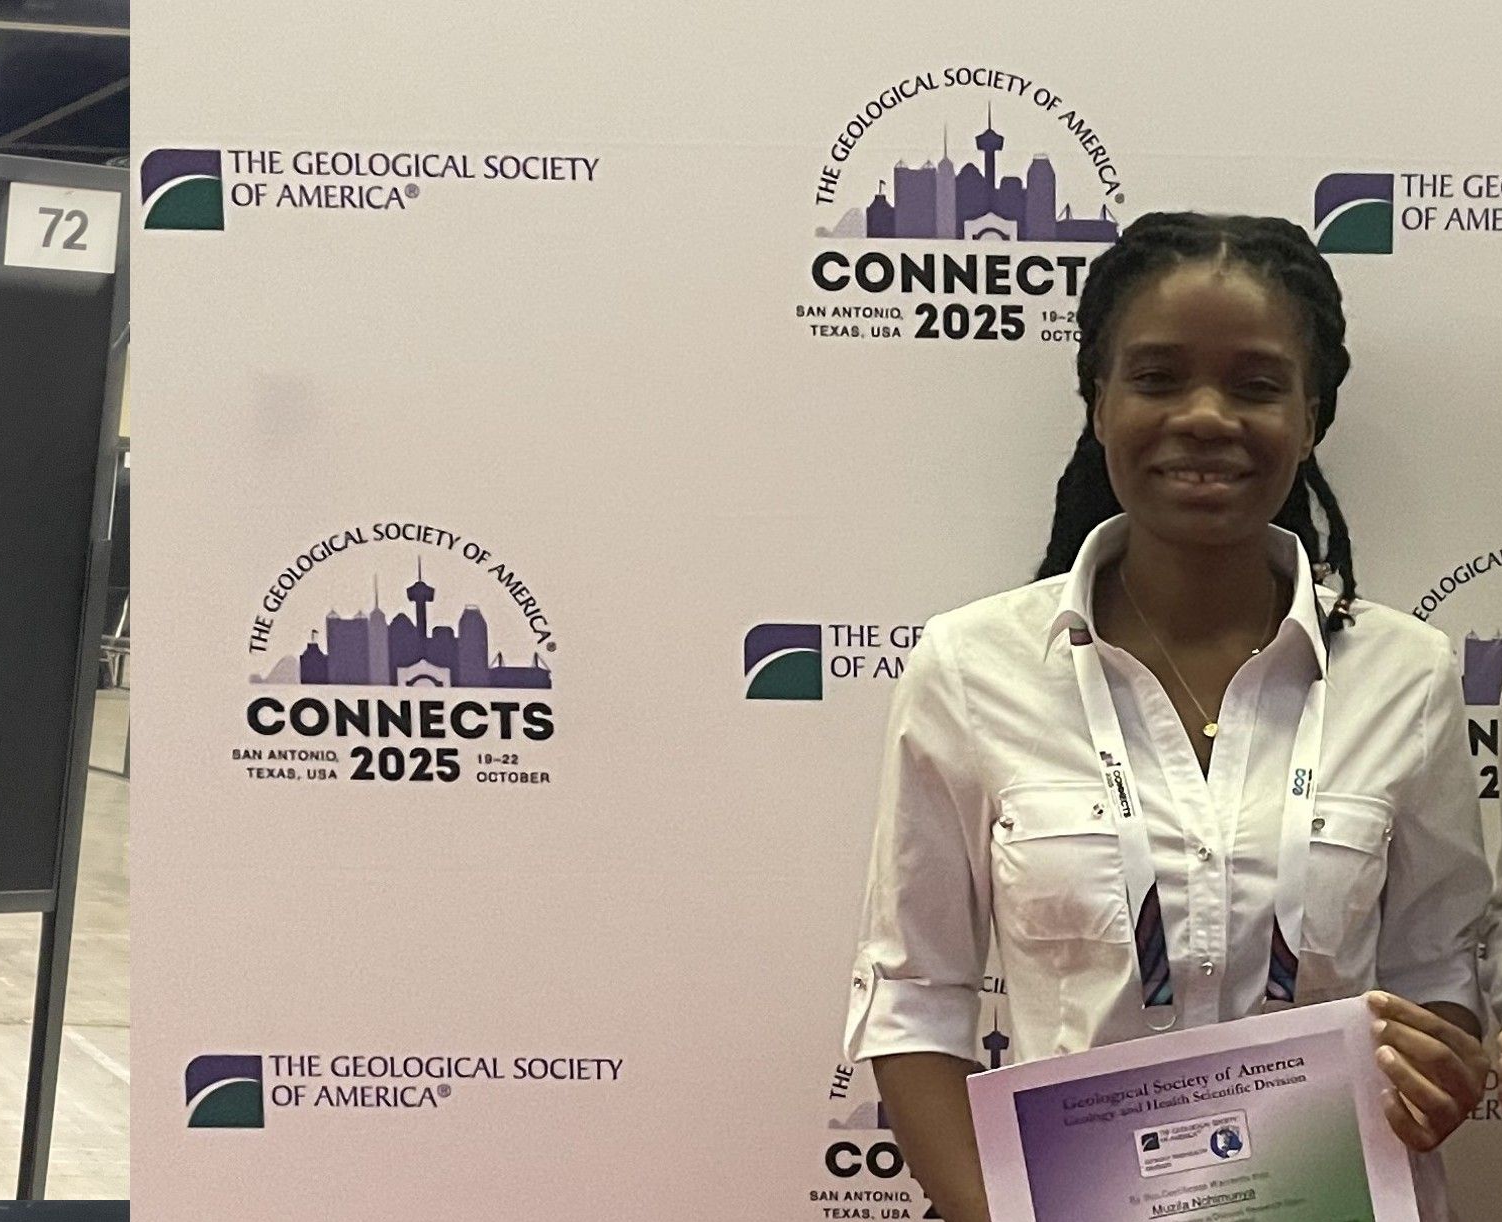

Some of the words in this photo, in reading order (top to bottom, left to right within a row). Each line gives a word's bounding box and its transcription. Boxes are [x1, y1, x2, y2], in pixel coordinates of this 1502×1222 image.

[228, 152, 284, 175] THE
[293, 152, 474, 178] GEOLOGICAL
[483, 156, 599, 181] SOCIETY
[231, 184, 269, 209] OF
[38, 207, 88, 251] 72
[812, 251, 1088, 296] CONNECT
[915, 303, 1025, 341] 2025
[249, 616, 273, 654] THE
[263, 527, 369, 614] GEOLOGICAL
[372, 522, 462, 550] SOCIETY
[462, 540, 491, 567] OF
[246, 697, 555, 741] CONNECTS
[232, 750, 261, 761] SAN
[307, 768, 338, 779] USA
[350, 747, 461, 783] 2025
[476, 772, 551, 783] OCTOBER
[1062, 1083, 1148, 1111] Geological
[1153, 1072, 1209, 1094] Society
[1215, 1066, 1231, 1084] of
[1238, 1054, 1305, 1077] America
[1152, 1201, 1189, 1217] Muzila
